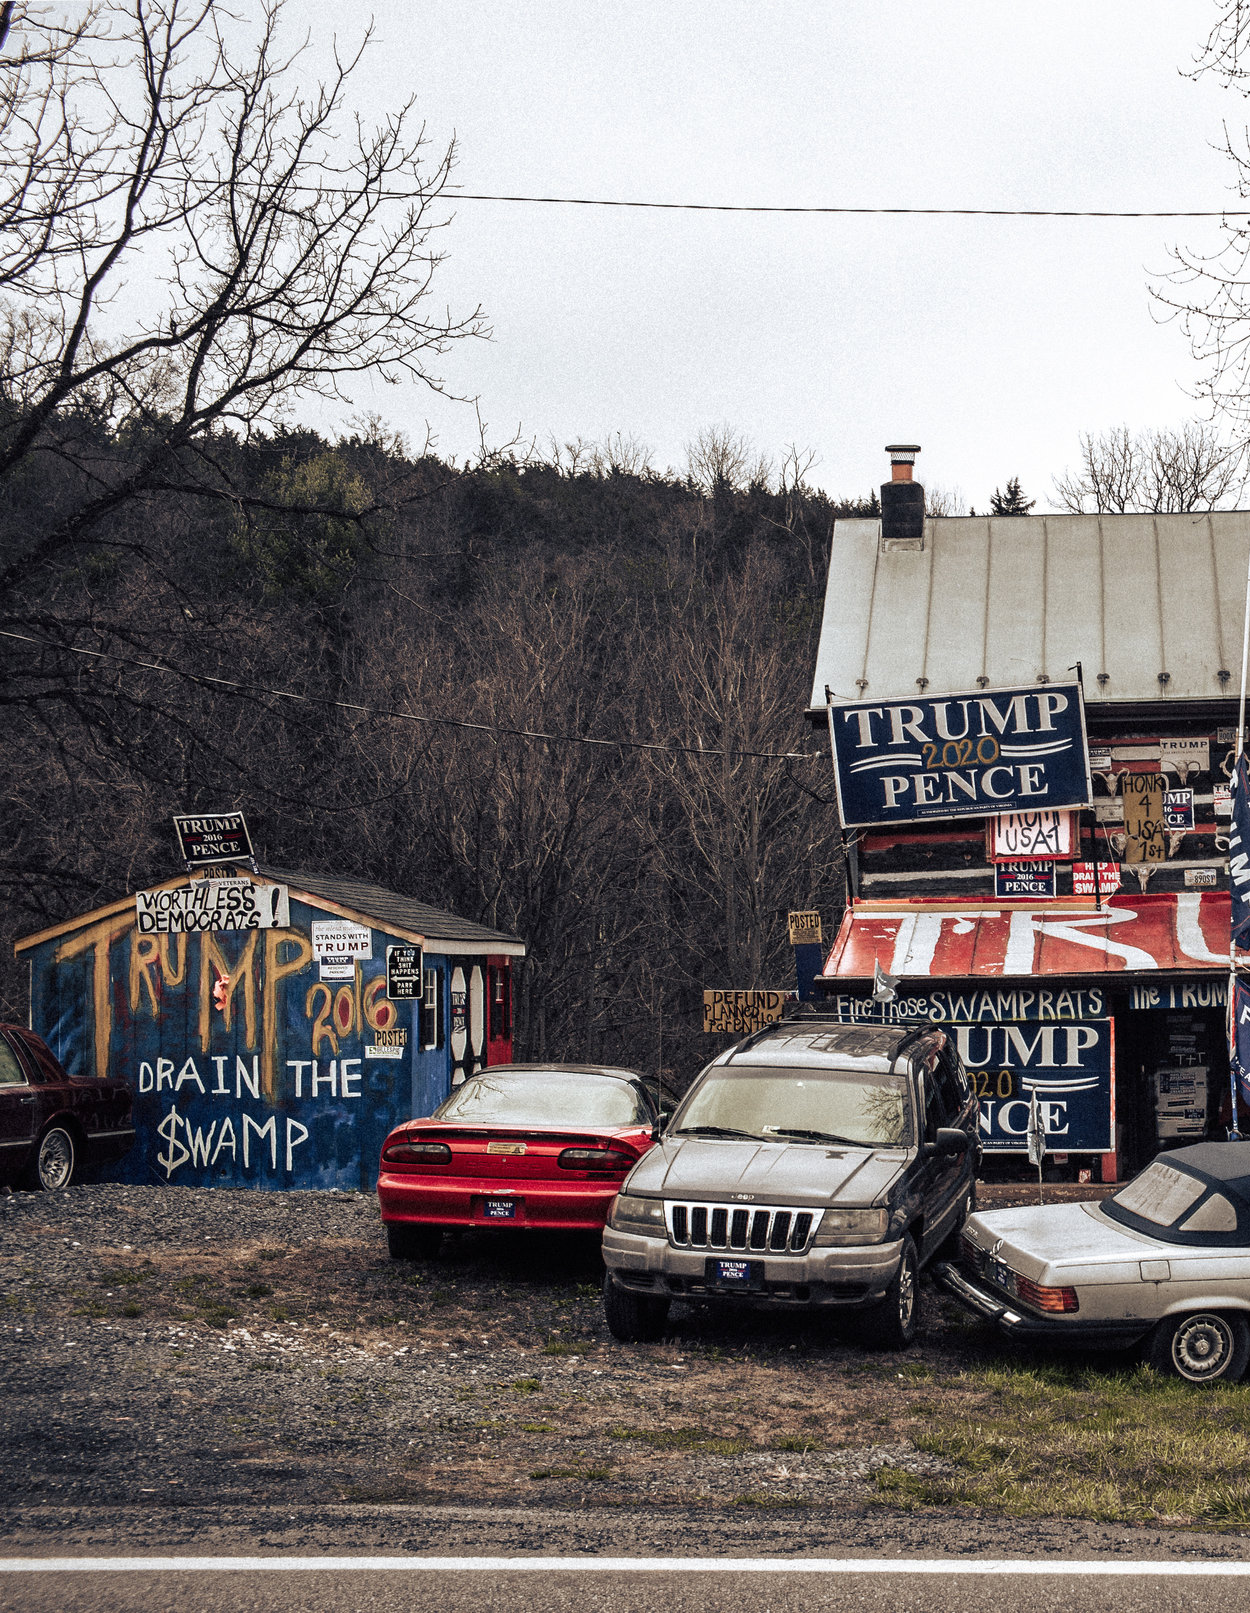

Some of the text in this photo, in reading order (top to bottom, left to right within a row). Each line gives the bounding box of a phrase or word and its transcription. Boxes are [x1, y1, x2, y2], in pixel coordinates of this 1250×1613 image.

[844, 693, 1069, 748] TRUMP
[922, 736, 1000, 769] 2020
[1161, 741, 1208, 750] TRUMP
[879, 764, 1049, 809] PENCE
[1124, 774, 1163, 793] HONK
[1138, 794, 1152, 818] 4
[179, 818, 241, 834] TRUMP
[1126, 819, 1164, 841] USA
[192, 842, 241, 856] PENCE
[1005, 882, 1046, 892] PENCE
[1103, 872, 1120, 880] THE
[138, 886, 256, 911] WORTHLESS
[139, 911, 261, 932] DEMOCRATS
[790, 914, 819, 928] POSTED
[315, 942, 369, 952] TRUMP
[714, 992, 779, 1010] DEFUND
[1170, 982, 1229, 1008] TRUM
[306, 975, 397, 1056] 2016
[837, 995, 873, 1023] Fire
[952, 1026, 1099, 1067] UMP
[139, 1055, 361, 1098] DRAIN THE
